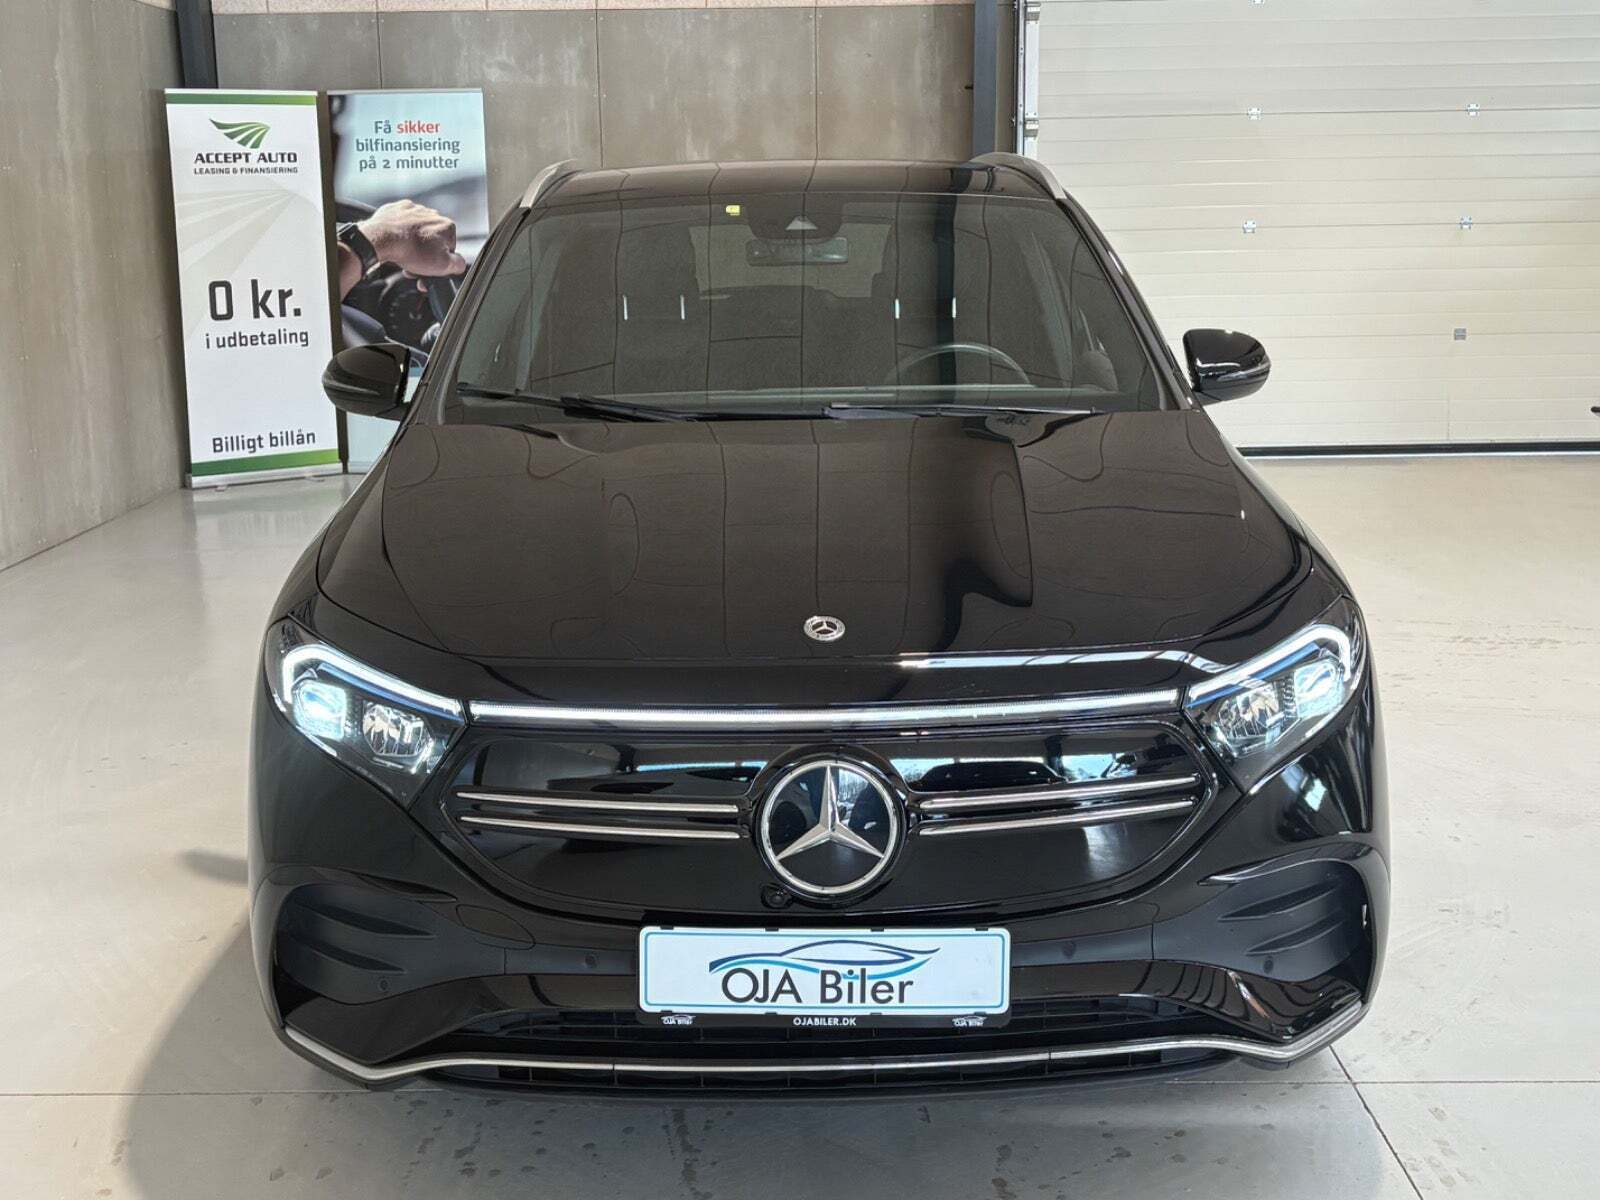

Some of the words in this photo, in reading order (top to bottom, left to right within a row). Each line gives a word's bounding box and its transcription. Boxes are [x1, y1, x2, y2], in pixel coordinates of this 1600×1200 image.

[374, 120, 392, 134] Få
[396, 120, 441, 134] sikker
[355, 137, 461, 154] bilfinansiering
[194, 152, 251, 164] ACCEPT
[257, 152, 298, 163] AUTO
[359, 155, 377, 172] på
[382, 159, 391, 169] 2
[396, 155, 459, 169] minutter
[194, 167, 230, 175] LEASING
[240, 166, 299, 174] FINANSIERING
[251, 278, 302, 319] kr.
[205, 333, 210, 349] i
[216, 328, 309, 348] udbetaling
[212, 434, 264, 454] Billigt
[269, 428, 316, 448] billån
[721, 967, 803, 1003] OJA
[819, 967, 914, 1004] Biler
[792, 1016, 857, 1027] OJABILER.DK
